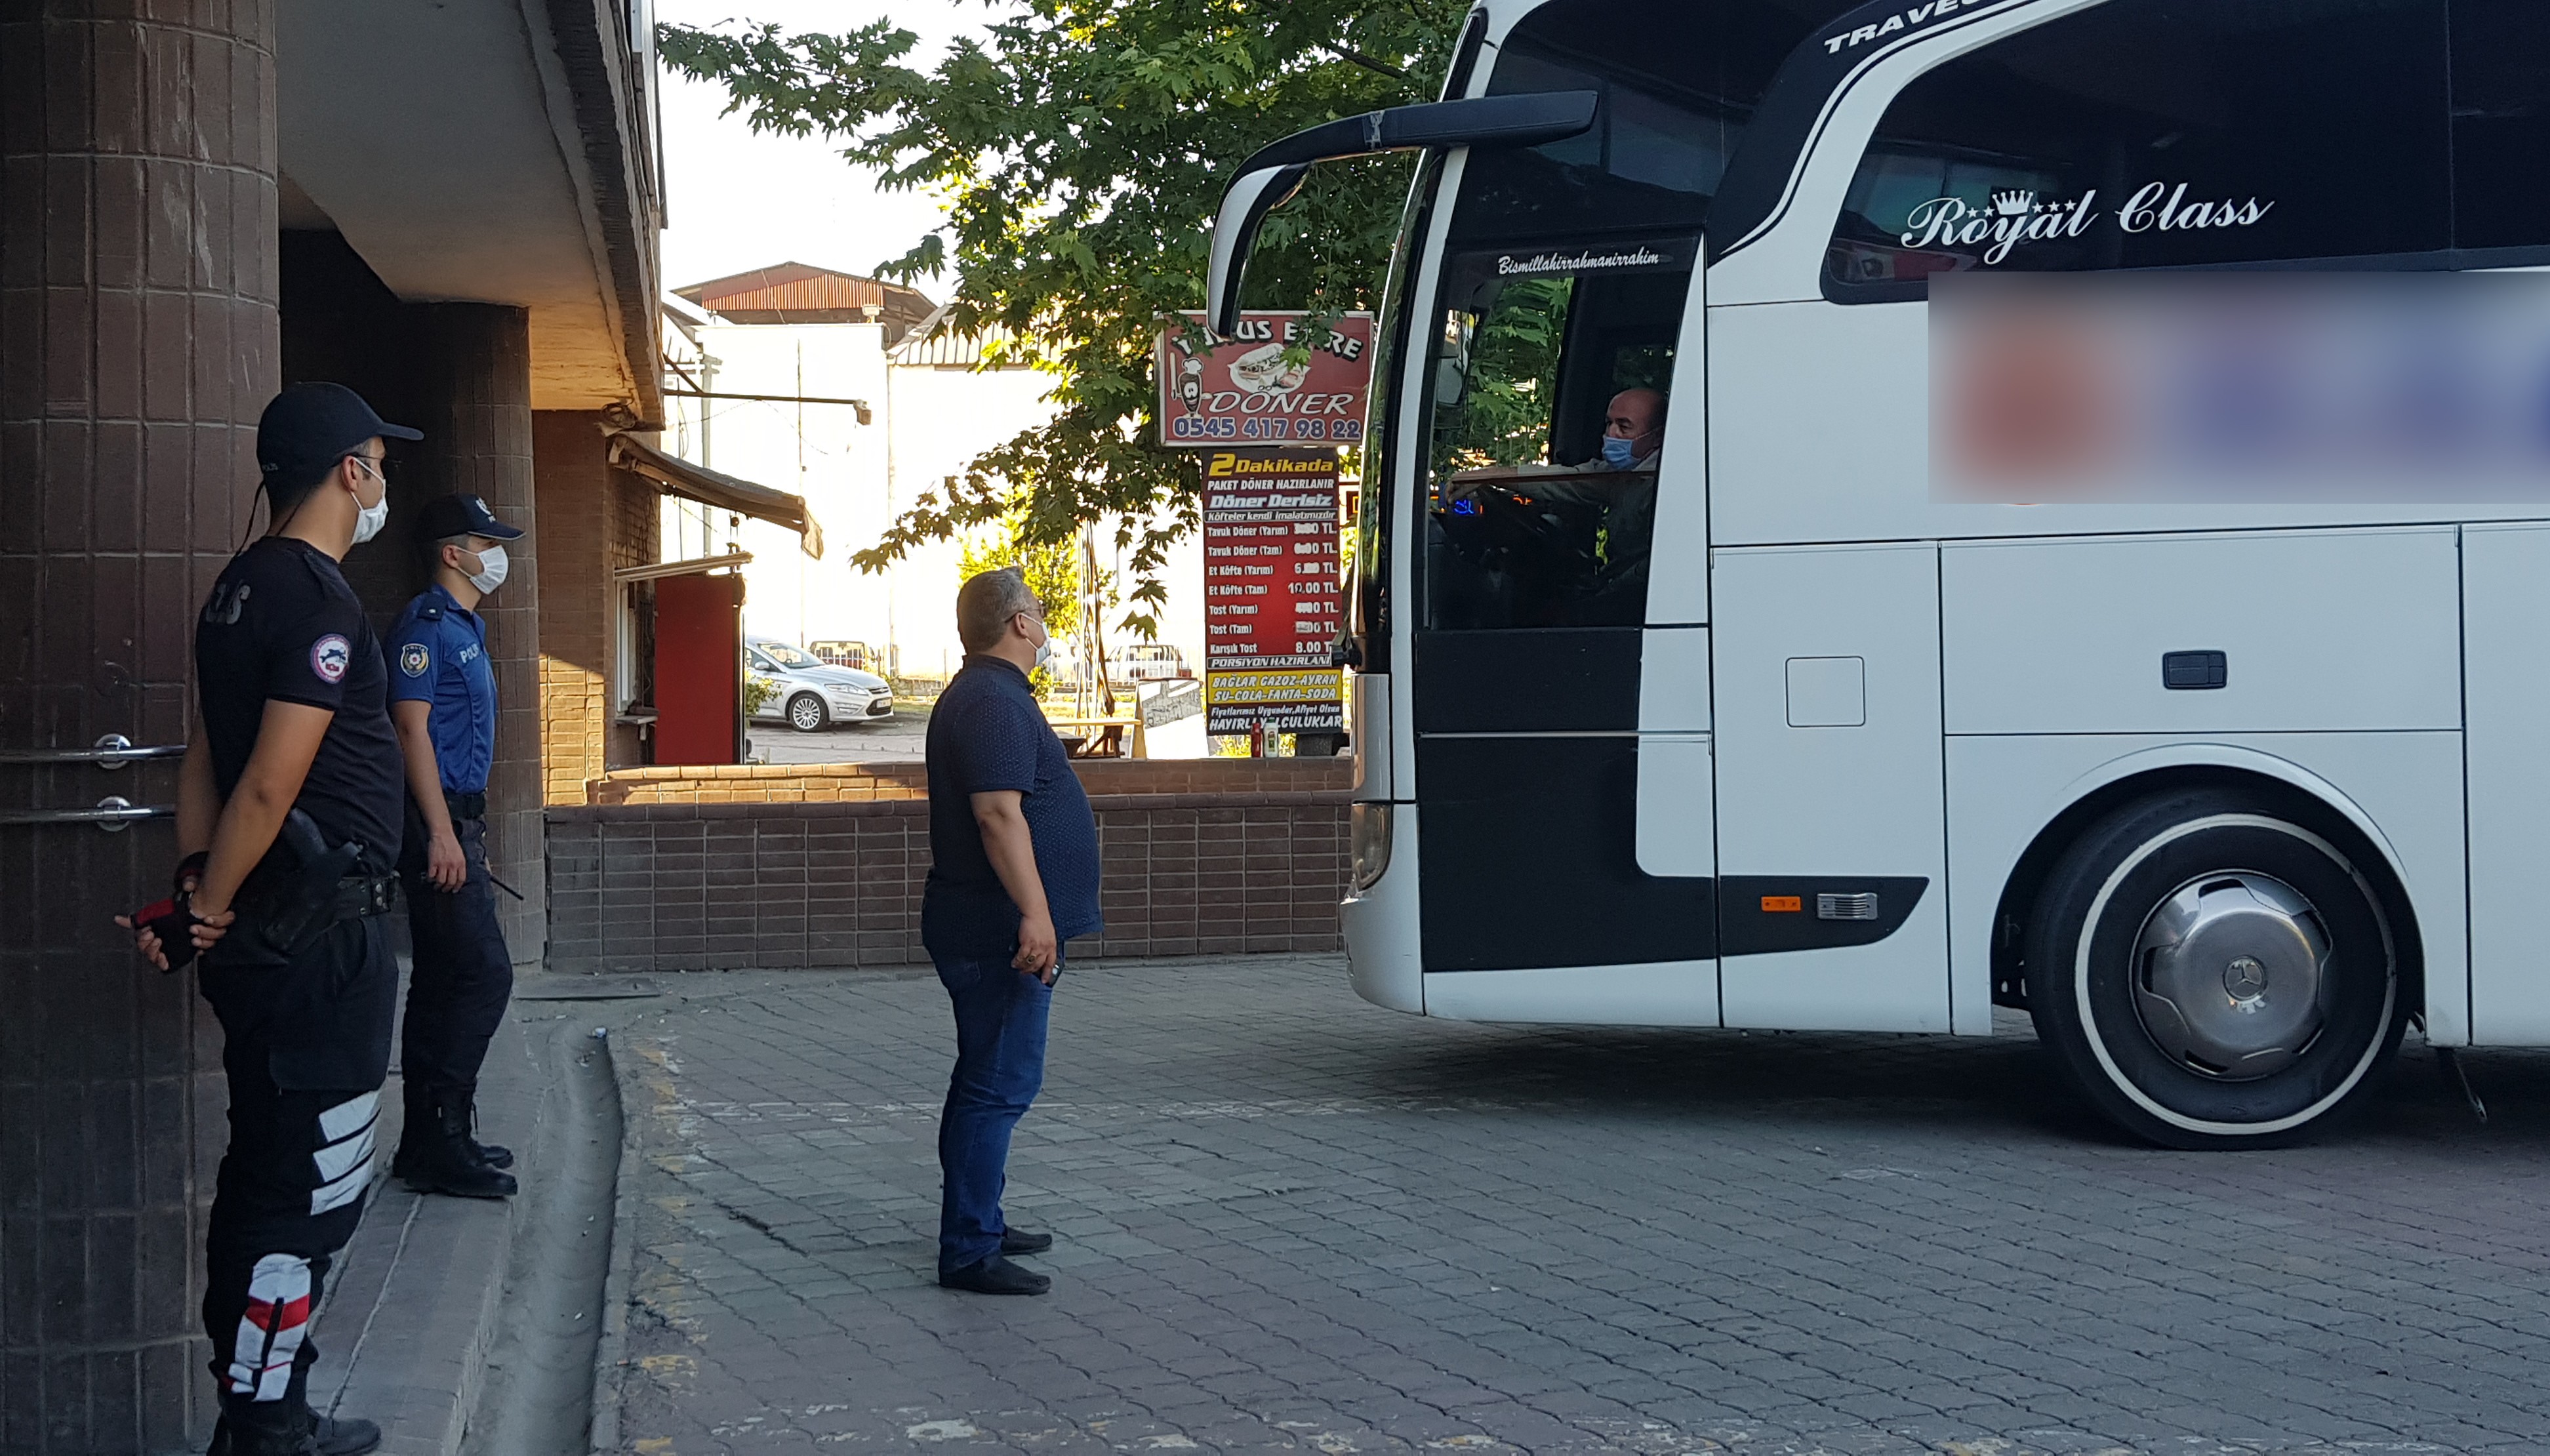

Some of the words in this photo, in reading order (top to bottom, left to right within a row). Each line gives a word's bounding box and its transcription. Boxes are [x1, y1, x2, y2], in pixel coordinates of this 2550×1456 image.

[1901, 190, 2099, 265] Royal
[2115, 181, 2275, 233] Class
[1208, 385, 1354, 415] DÖNER
[1174, 416, 1236, 437] 0545
[1243, 417, 1288, 439] 417
[1295, 418, 1326, 439] 98
[1330, 420, 1361, 439] 22
[1208, 453, 1236, 476] 2
[1235, 458, 1333, 472] Dakikada
[1207, 479, 1238, 491] PAKET
[1240, 477, 1274, 490] DÖNER
[1276, 478, 1334, 489] HAZIRLANIR
[1209, 494, 1268, 508] Döner
[1266, 493, 1333, 508] Derisiz
[1246, 511, 1273, 521] kendi
[1207, 527, 1232, 537] Tavuk
[1232, 525, 1258, 536] Döner
[1207, 546, 1232, 557] Tavuk
[1233, 545, 1258, 556] Döner
[1259, 545, 1283, 556] (Tam)
[1209, 566, 1218, 576] Et
[1219, 565, 1243, 576] Köfte
[1209, 586, 1218, 596] Et
[1219, 585, 1243, 596] Köfte
[1244, 584, 1268, 595] (Tam)
[1209, 605, 1227, 615] Tost
[1209, 624, 1227, 635] Tost
[1229, 624, 1253, 634] (Tam)
[1239, 643, 1258, 653] Tost
[1295, 641, 1322, 653] 8.00
[1212, 674, 1257, 688] BAĞLAR
[1259, 715, 1343, 729] YLCULUKLAR
